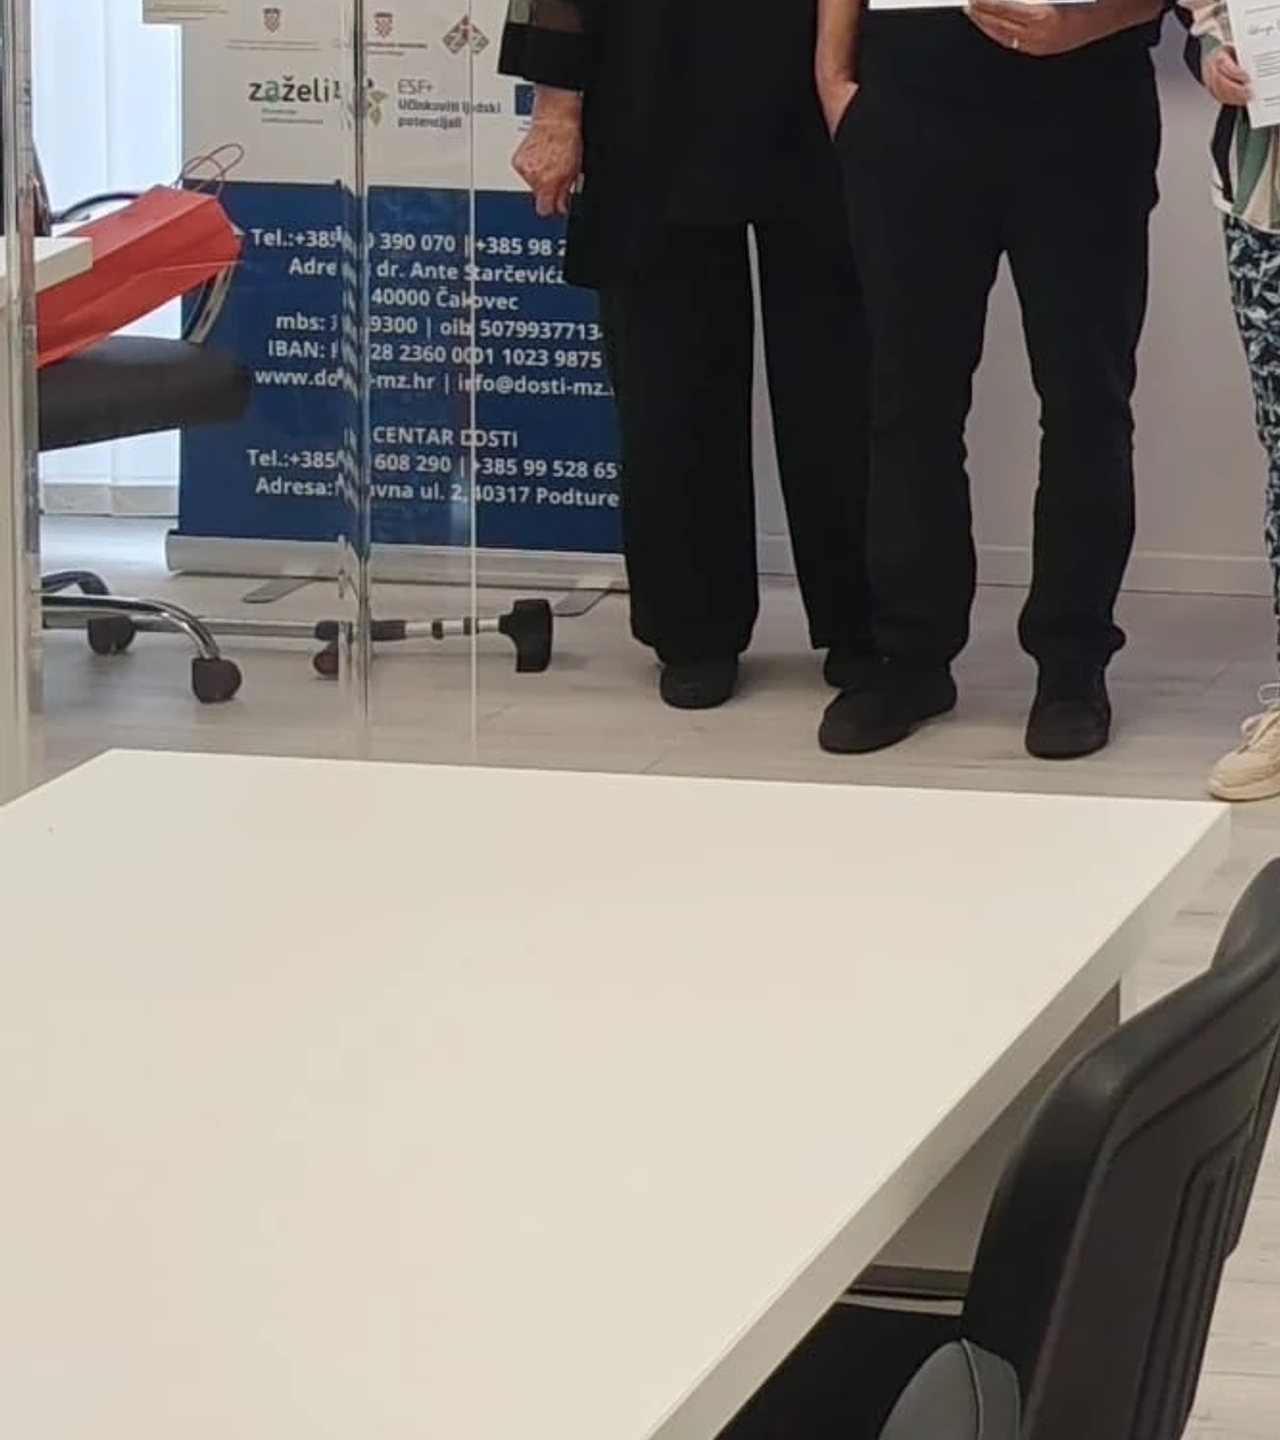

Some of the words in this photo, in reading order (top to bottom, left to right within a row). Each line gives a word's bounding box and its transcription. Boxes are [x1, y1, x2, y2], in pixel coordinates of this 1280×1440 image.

[379, 233, 416, 251] 390
[420, 234, 456, 252] 070
[476, 236, 523, 256] +385
[527, 239, 552, 257] 98
[376, 260, 405, 279] dr.
[410, 262, 459, 280] Ante
[371, 288, 431, 307] 40000
[276, 312, 325, 331] mbs:
[479, 320, 604, 341] 5079937713
[268, 339, 326, 360] IBAN:
[398, 344, 447, 364] 2360
[502, 348, 549, 366] 1023
[554, 350, 603, 369] 9875
[372, 426, 454, 446] CENTAR
[374, 453, 411, 472] 608
[415, 455, 452, 473] 290
[523, 459, 547, 477] 99
[552, 461, 589, 479] 528
[255, 476, 334, 497] Adresa:
[419, 481, 446, 502] ul.
